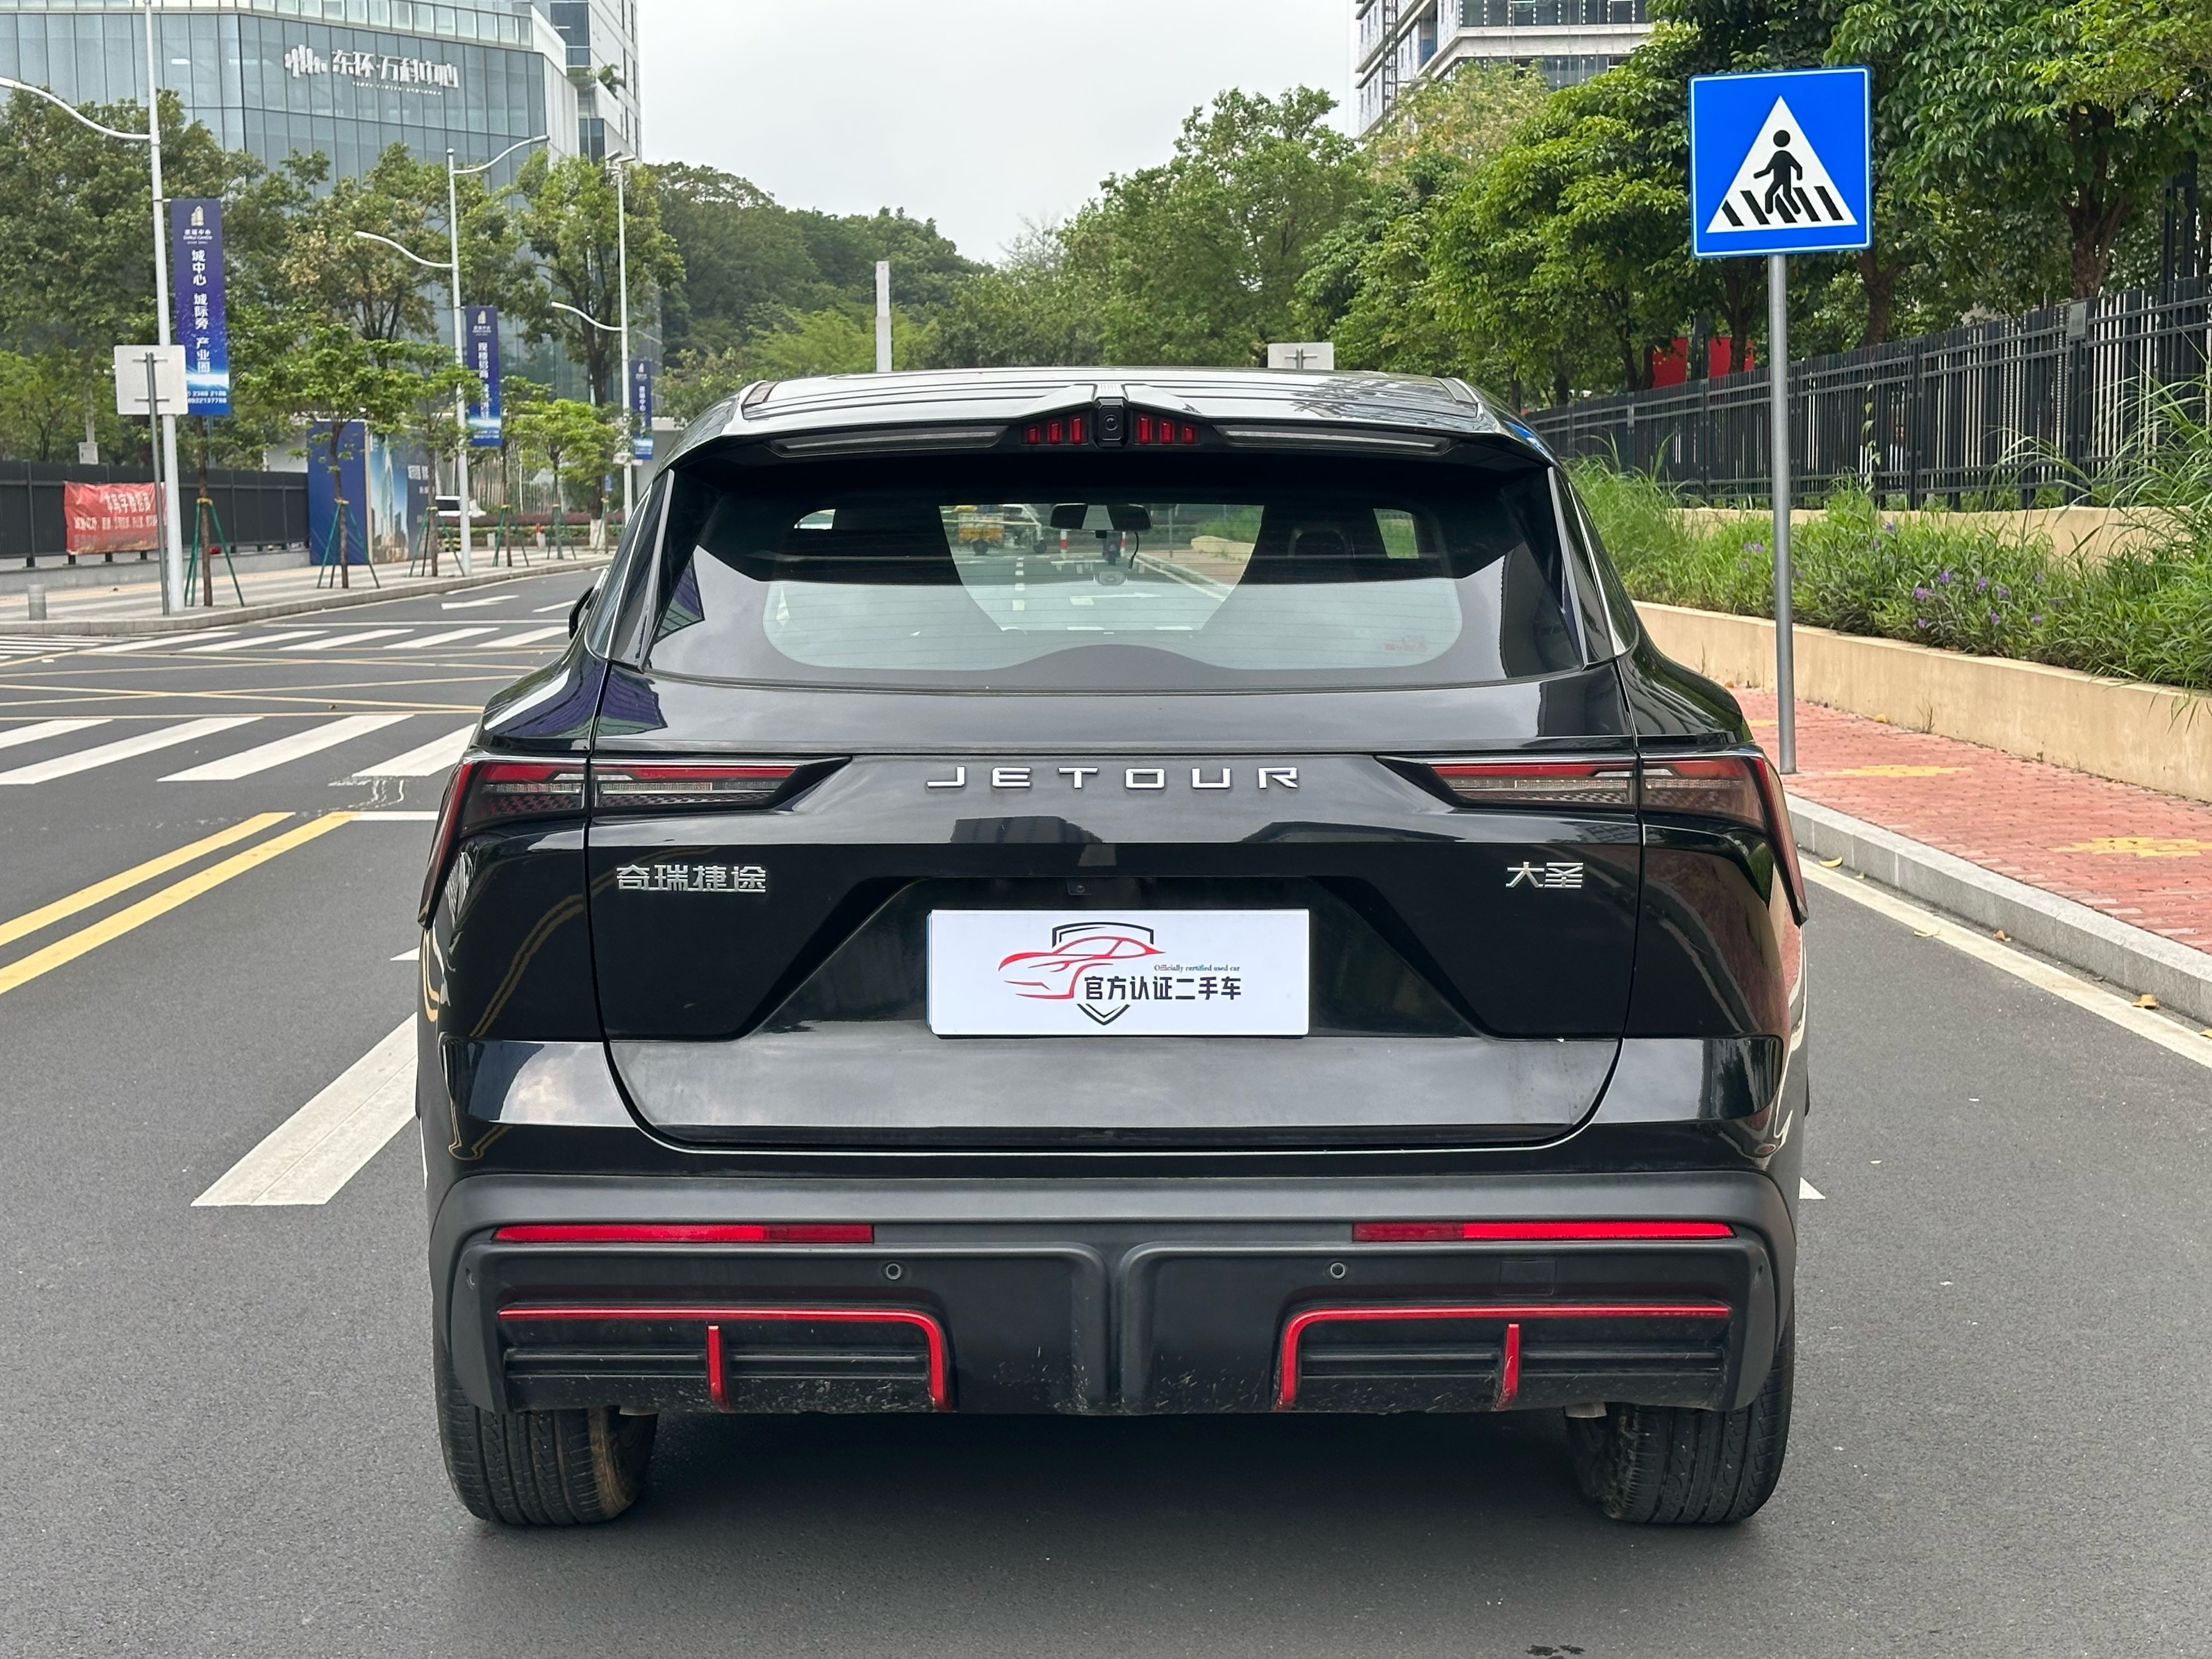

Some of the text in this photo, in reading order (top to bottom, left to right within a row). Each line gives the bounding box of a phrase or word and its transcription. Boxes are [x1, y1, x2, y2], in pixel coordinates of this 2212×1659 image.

[191, 249, 207, 286] 城中心
[926, 766, 1299, 789] JETOUR
[616, 864, 766, 892] 奇瑞捷途
[1505, 861, 1584, 888] 大圣
[1154, 964, 1183, 973] Officially
[1084, 976, 1241, 1000] 官方认证二手车
